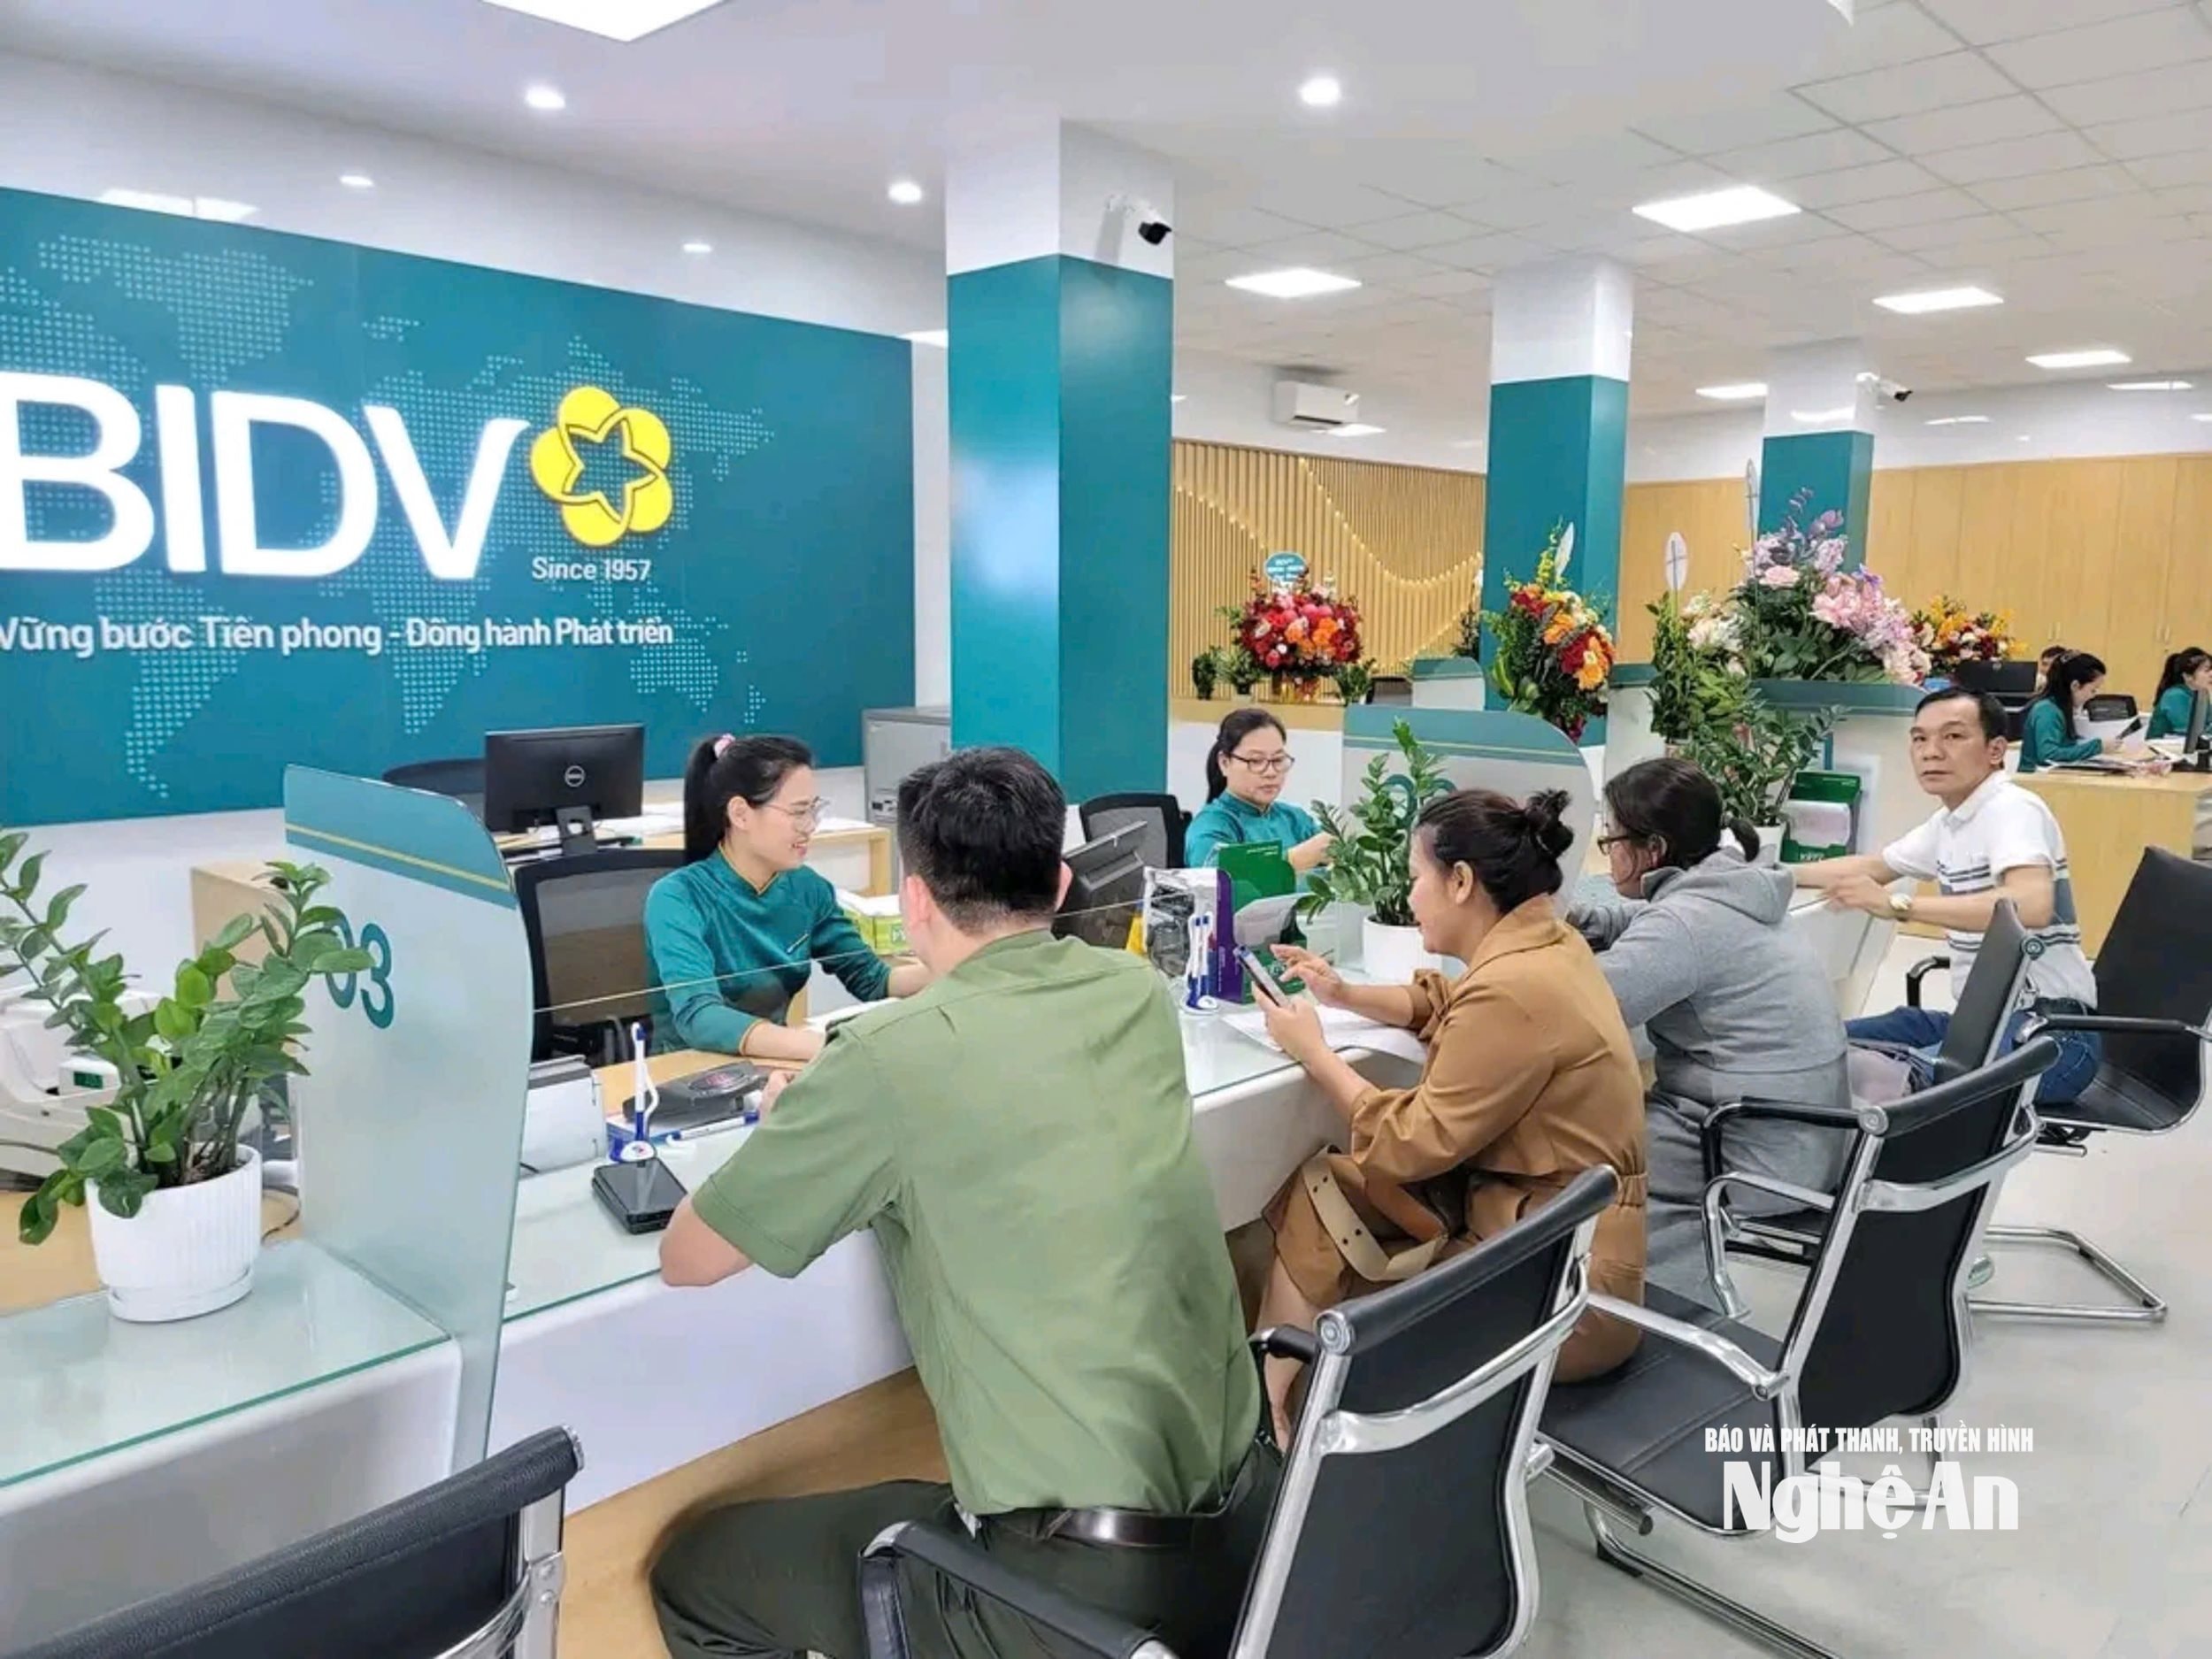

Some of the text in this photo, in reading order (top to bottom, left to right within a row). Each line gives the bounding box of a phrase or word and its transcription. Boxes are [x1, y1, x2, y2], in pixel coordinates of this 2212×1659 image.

[0, 372, 530, 580] BIDV
[532, 556, 652, 580] Since 1957
[0, 615, 94, 658] Vững
[98, 615, 194, 649] bước
[197, 617, 275, 649] Tiên
[280, 617, 382, 657] phong
[406, 617, 480, 654] Đồng
[485, 617, 551, 647] hành
[555, 617, 614, 645] Phát
[616, 616, 673, 644] triển
